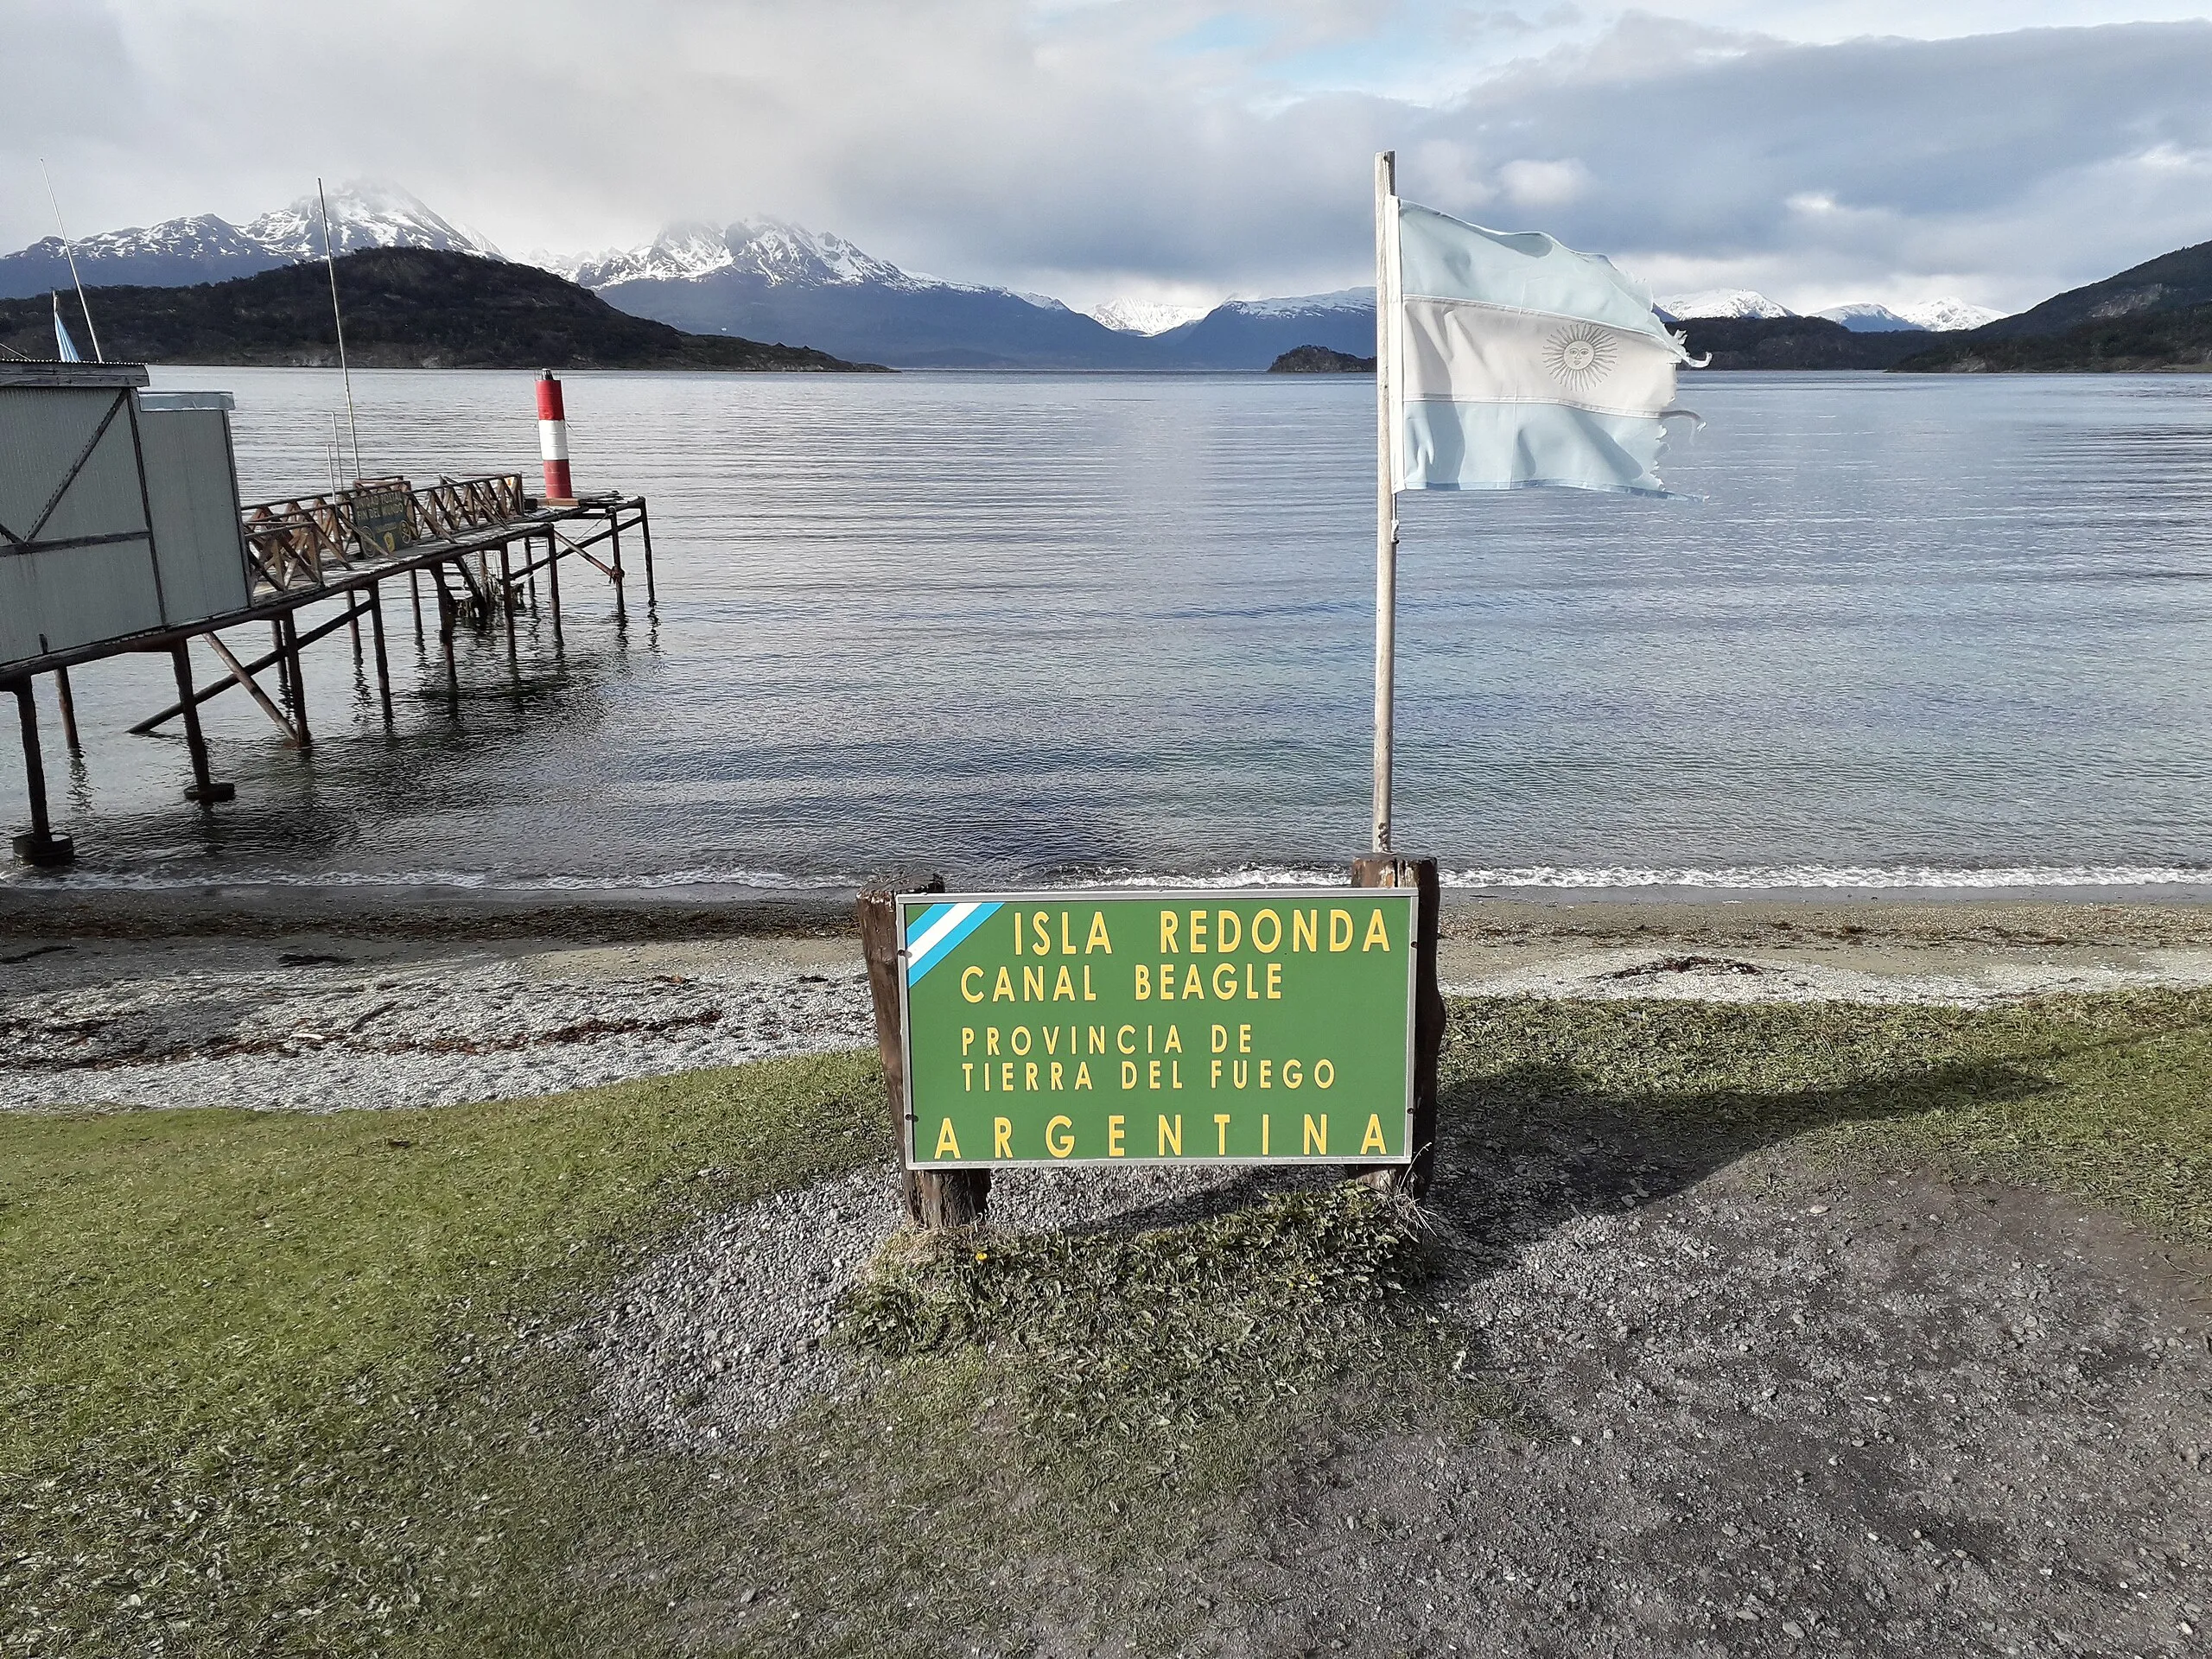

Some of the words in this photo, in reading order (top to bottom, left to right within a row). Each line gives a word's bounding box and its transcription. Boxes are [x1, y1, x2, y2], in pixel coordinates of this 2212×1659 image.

[1014, 910, 1113, 957] ISLA
[1159, 907, 1391, 955] REDONDA
[960, 964, 1097, 1004] CANAL
[1134, 962, 1283, 1002] BEAGLE
[961, 1023, 1183, 1058] PROVINCIA
[1211, 1023, 1252, 1054] DE
[961, 1060, 1094, 1092] TIERRA
[1121, 1059, 1184, 1090] DEL
[1210, 1058, 1336, 1090] FUEGO
[933, 1112, 1388, 1160] ARGENTINA
